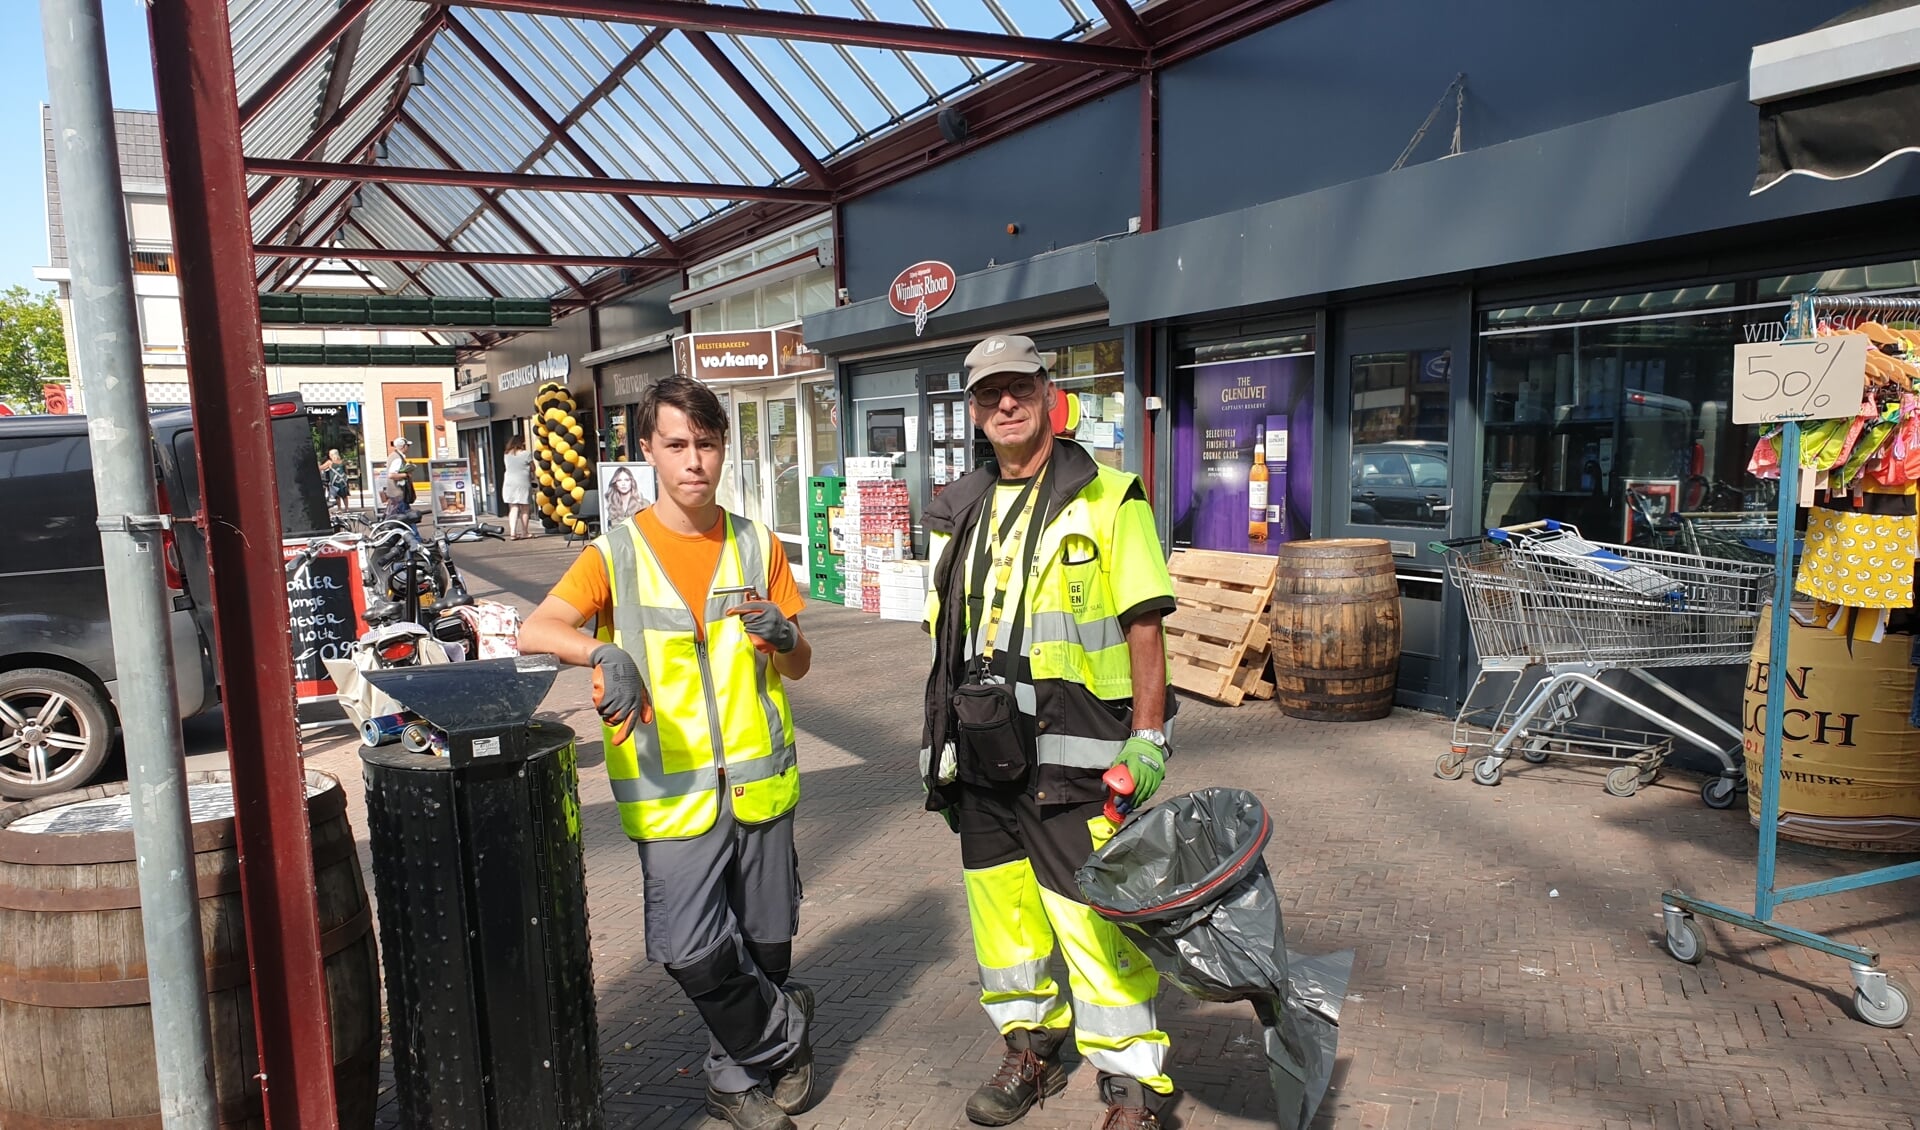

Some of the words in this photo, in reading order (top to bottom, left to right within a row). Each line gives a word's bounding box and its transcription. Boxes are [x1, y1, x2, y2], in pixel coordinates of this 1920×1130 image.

[895, 278, 924, 305] Wijnhuis
[924, 274, 948, 295] Rhoon
[696, 341, 746, 350] MEESTERBAKKER
[701, 352, 768, 370] voskamp
[1742, 340, 1846, 411] 50%
[1237, 376, 1251, 387] THE
[1221, 386, 1267, 403] GLENLIVET
[1205, 428, 1237, 439] SELECTIVELY
[1206, 440, 1228, 449] FINISHED
[1229, 440, 1236, 448] IN
[1202, 451, 1221, 460] COGNAC
[1222, 450, 1239, 460] CASKS
[1071, 585, 1081, 593] GE
[1780, 769, 1855, 785] WHISKY
